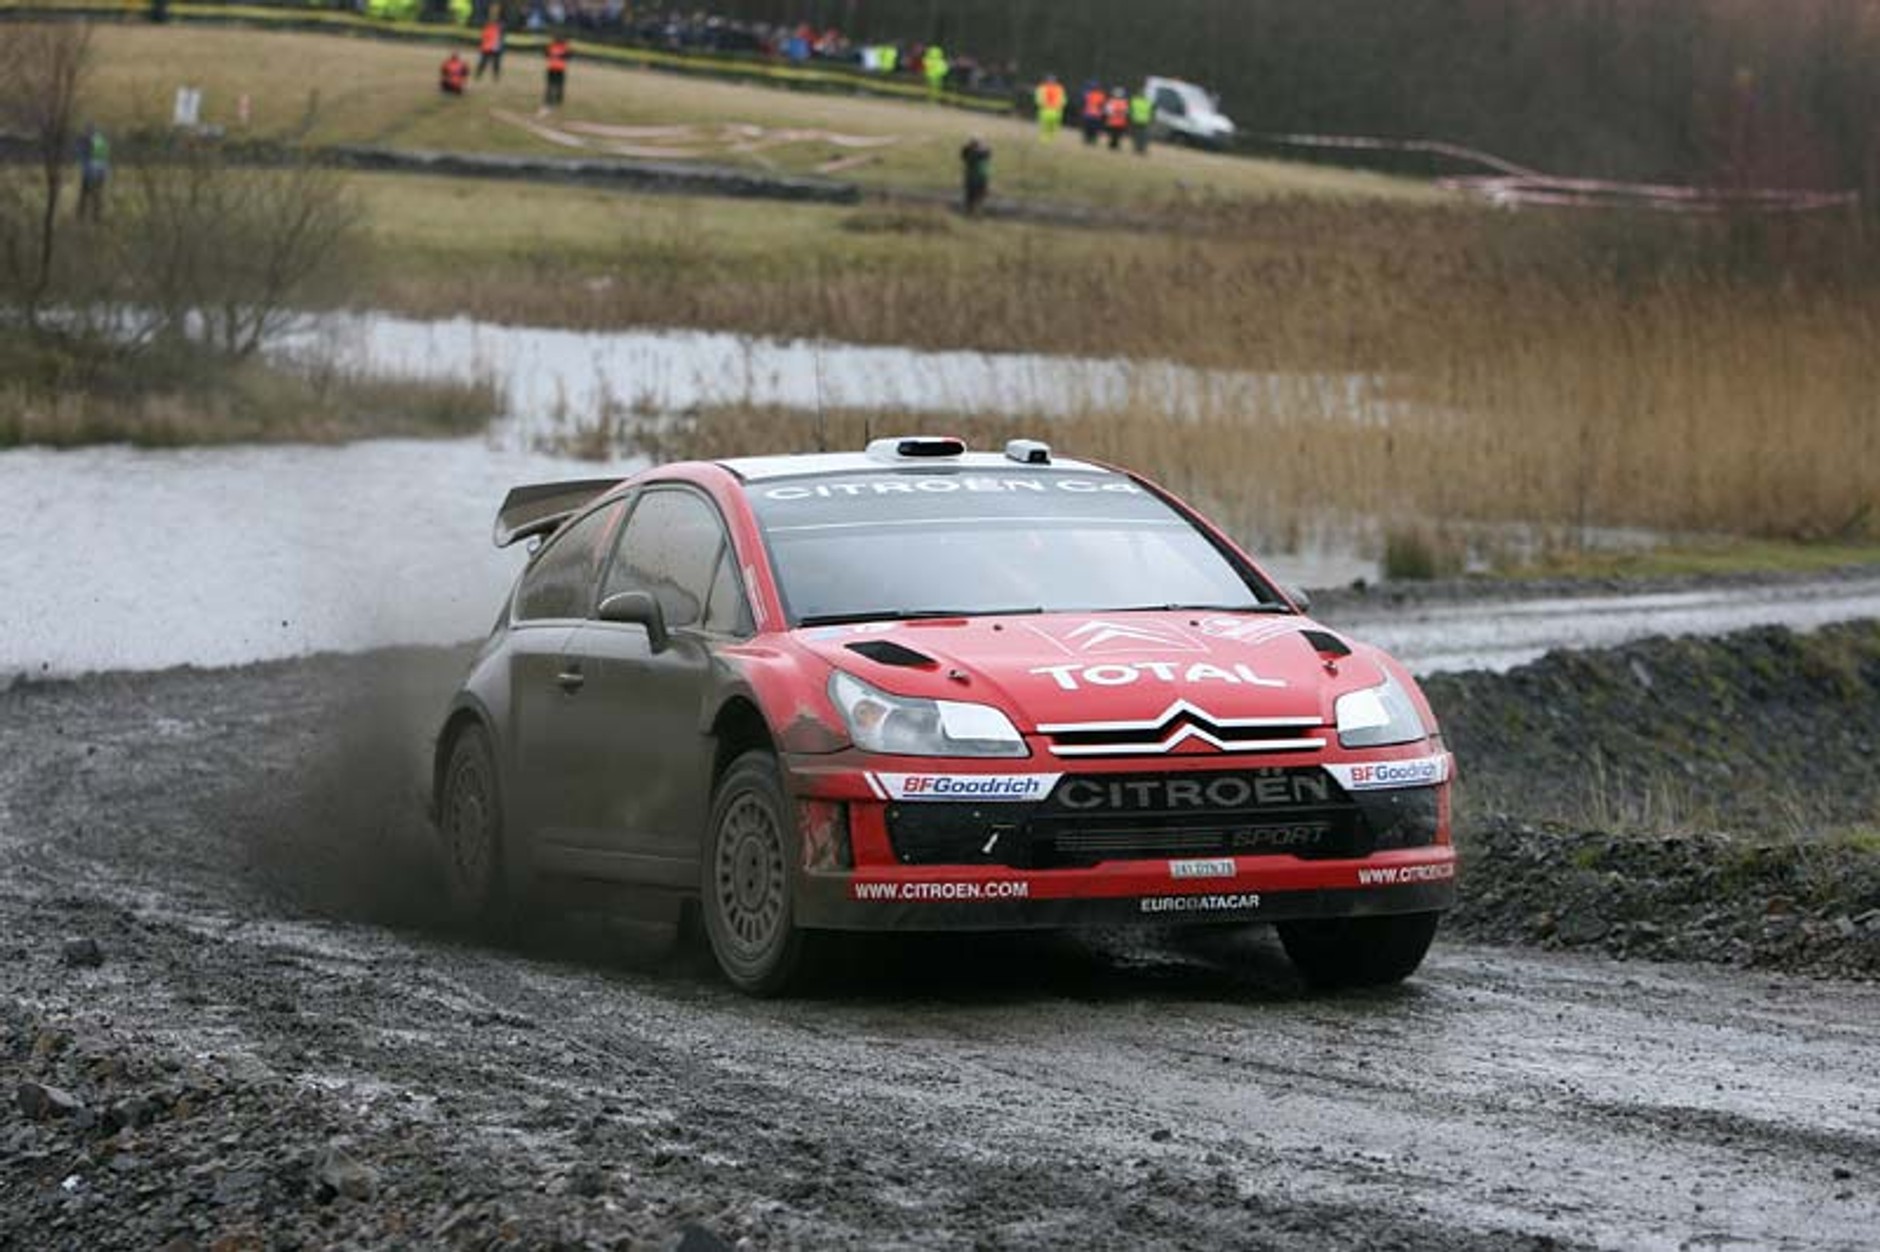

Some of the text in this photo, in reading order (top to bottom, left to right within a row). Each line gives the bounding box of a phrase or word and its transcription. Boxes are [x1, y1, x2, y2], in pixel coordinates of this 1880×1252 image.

[1055, 479, 1140, 495] C4
[1029, 661, 1287, 690] TOTAL
[902, 776, 1040, 794] BFGoodrich
[1058, 768, 1329, 808] CITROËN
[1231, 826, 1329, 847] SPORT
[855, 882, 1029, 899] WWW.CITROEN.COM
[1140, 894, 1260, 912] EURODATACAR
